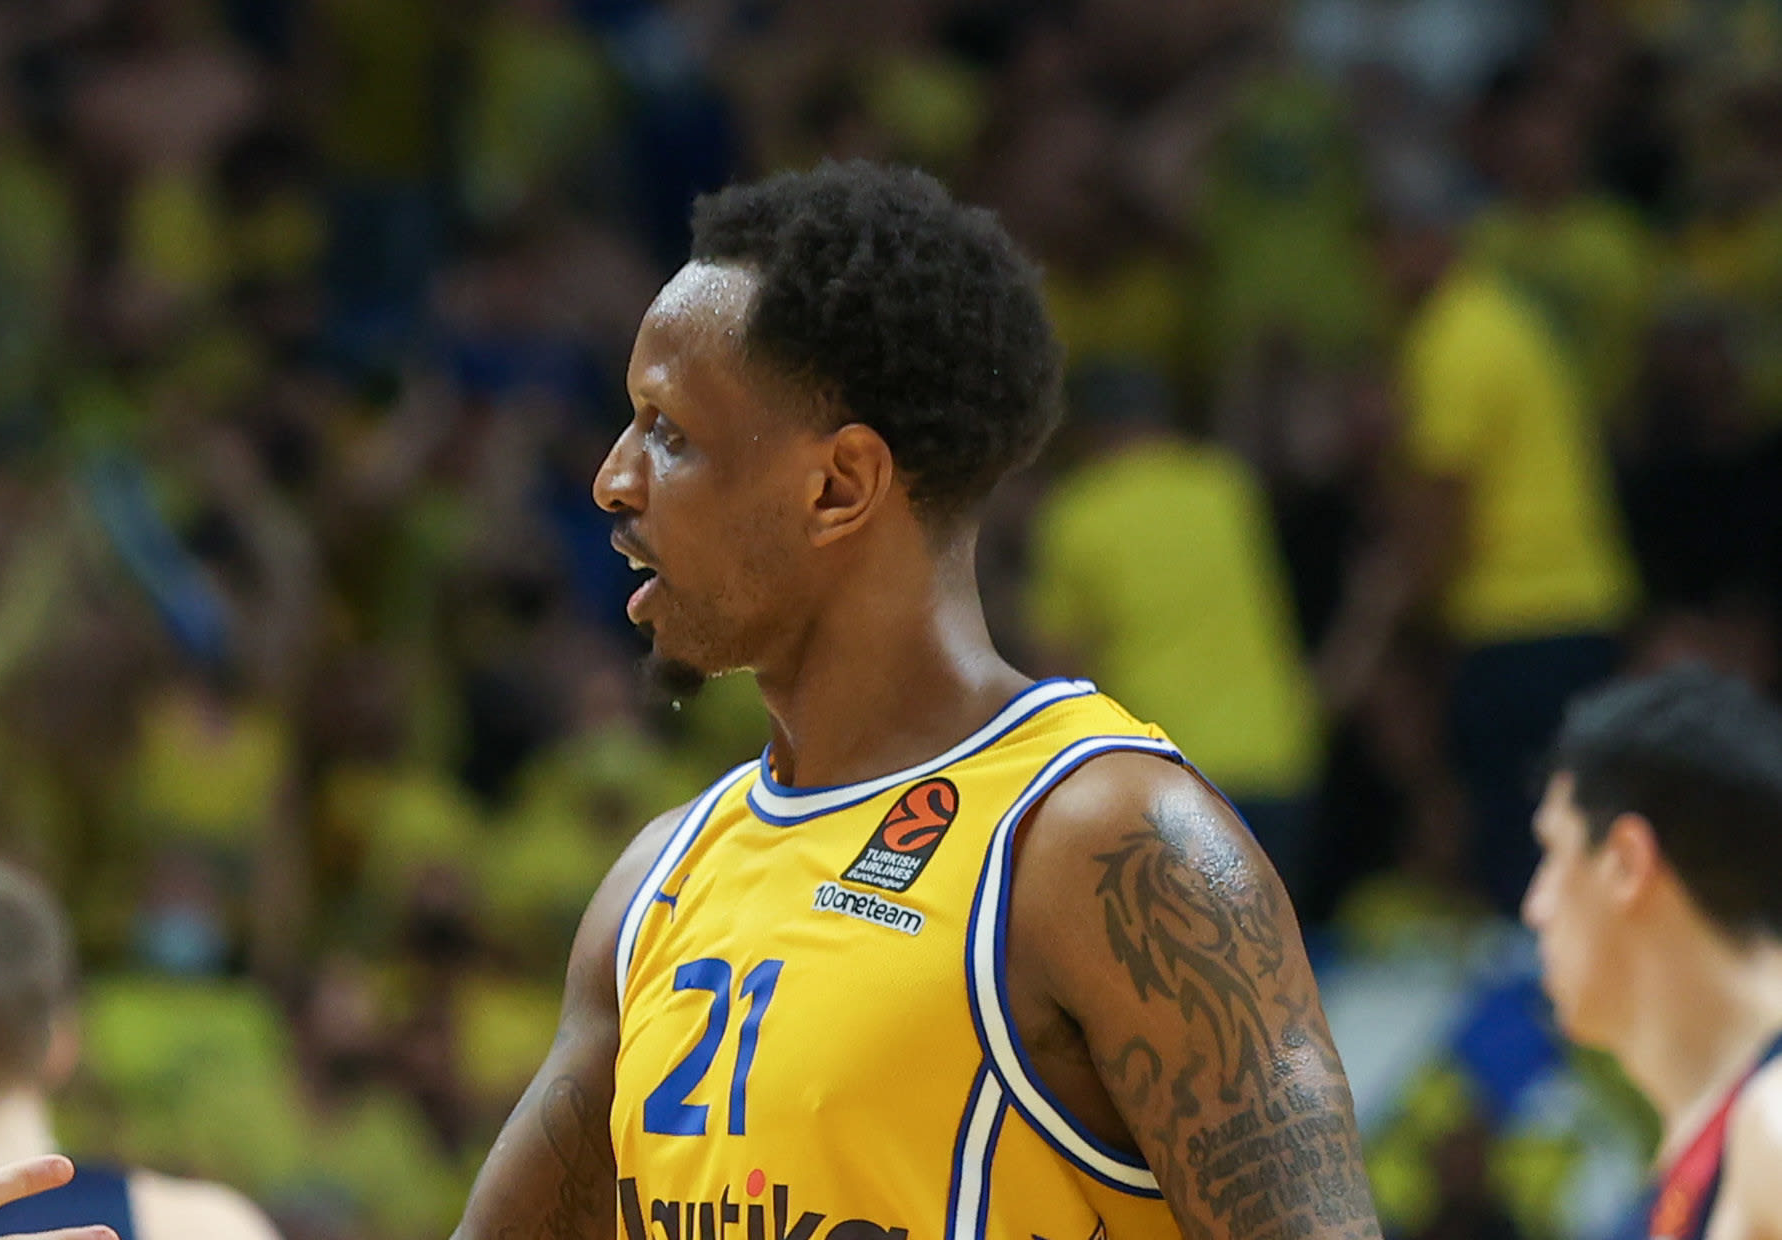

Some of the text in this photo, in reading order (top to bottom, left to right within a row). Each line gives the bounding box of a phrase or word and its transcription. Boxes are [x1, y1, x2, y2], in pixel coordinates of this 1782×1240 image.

[866, 848, 921, 870] TURKISH
[855, 860, 915, 881] AIRLINES
[643, 957, 785, 1136] 21
